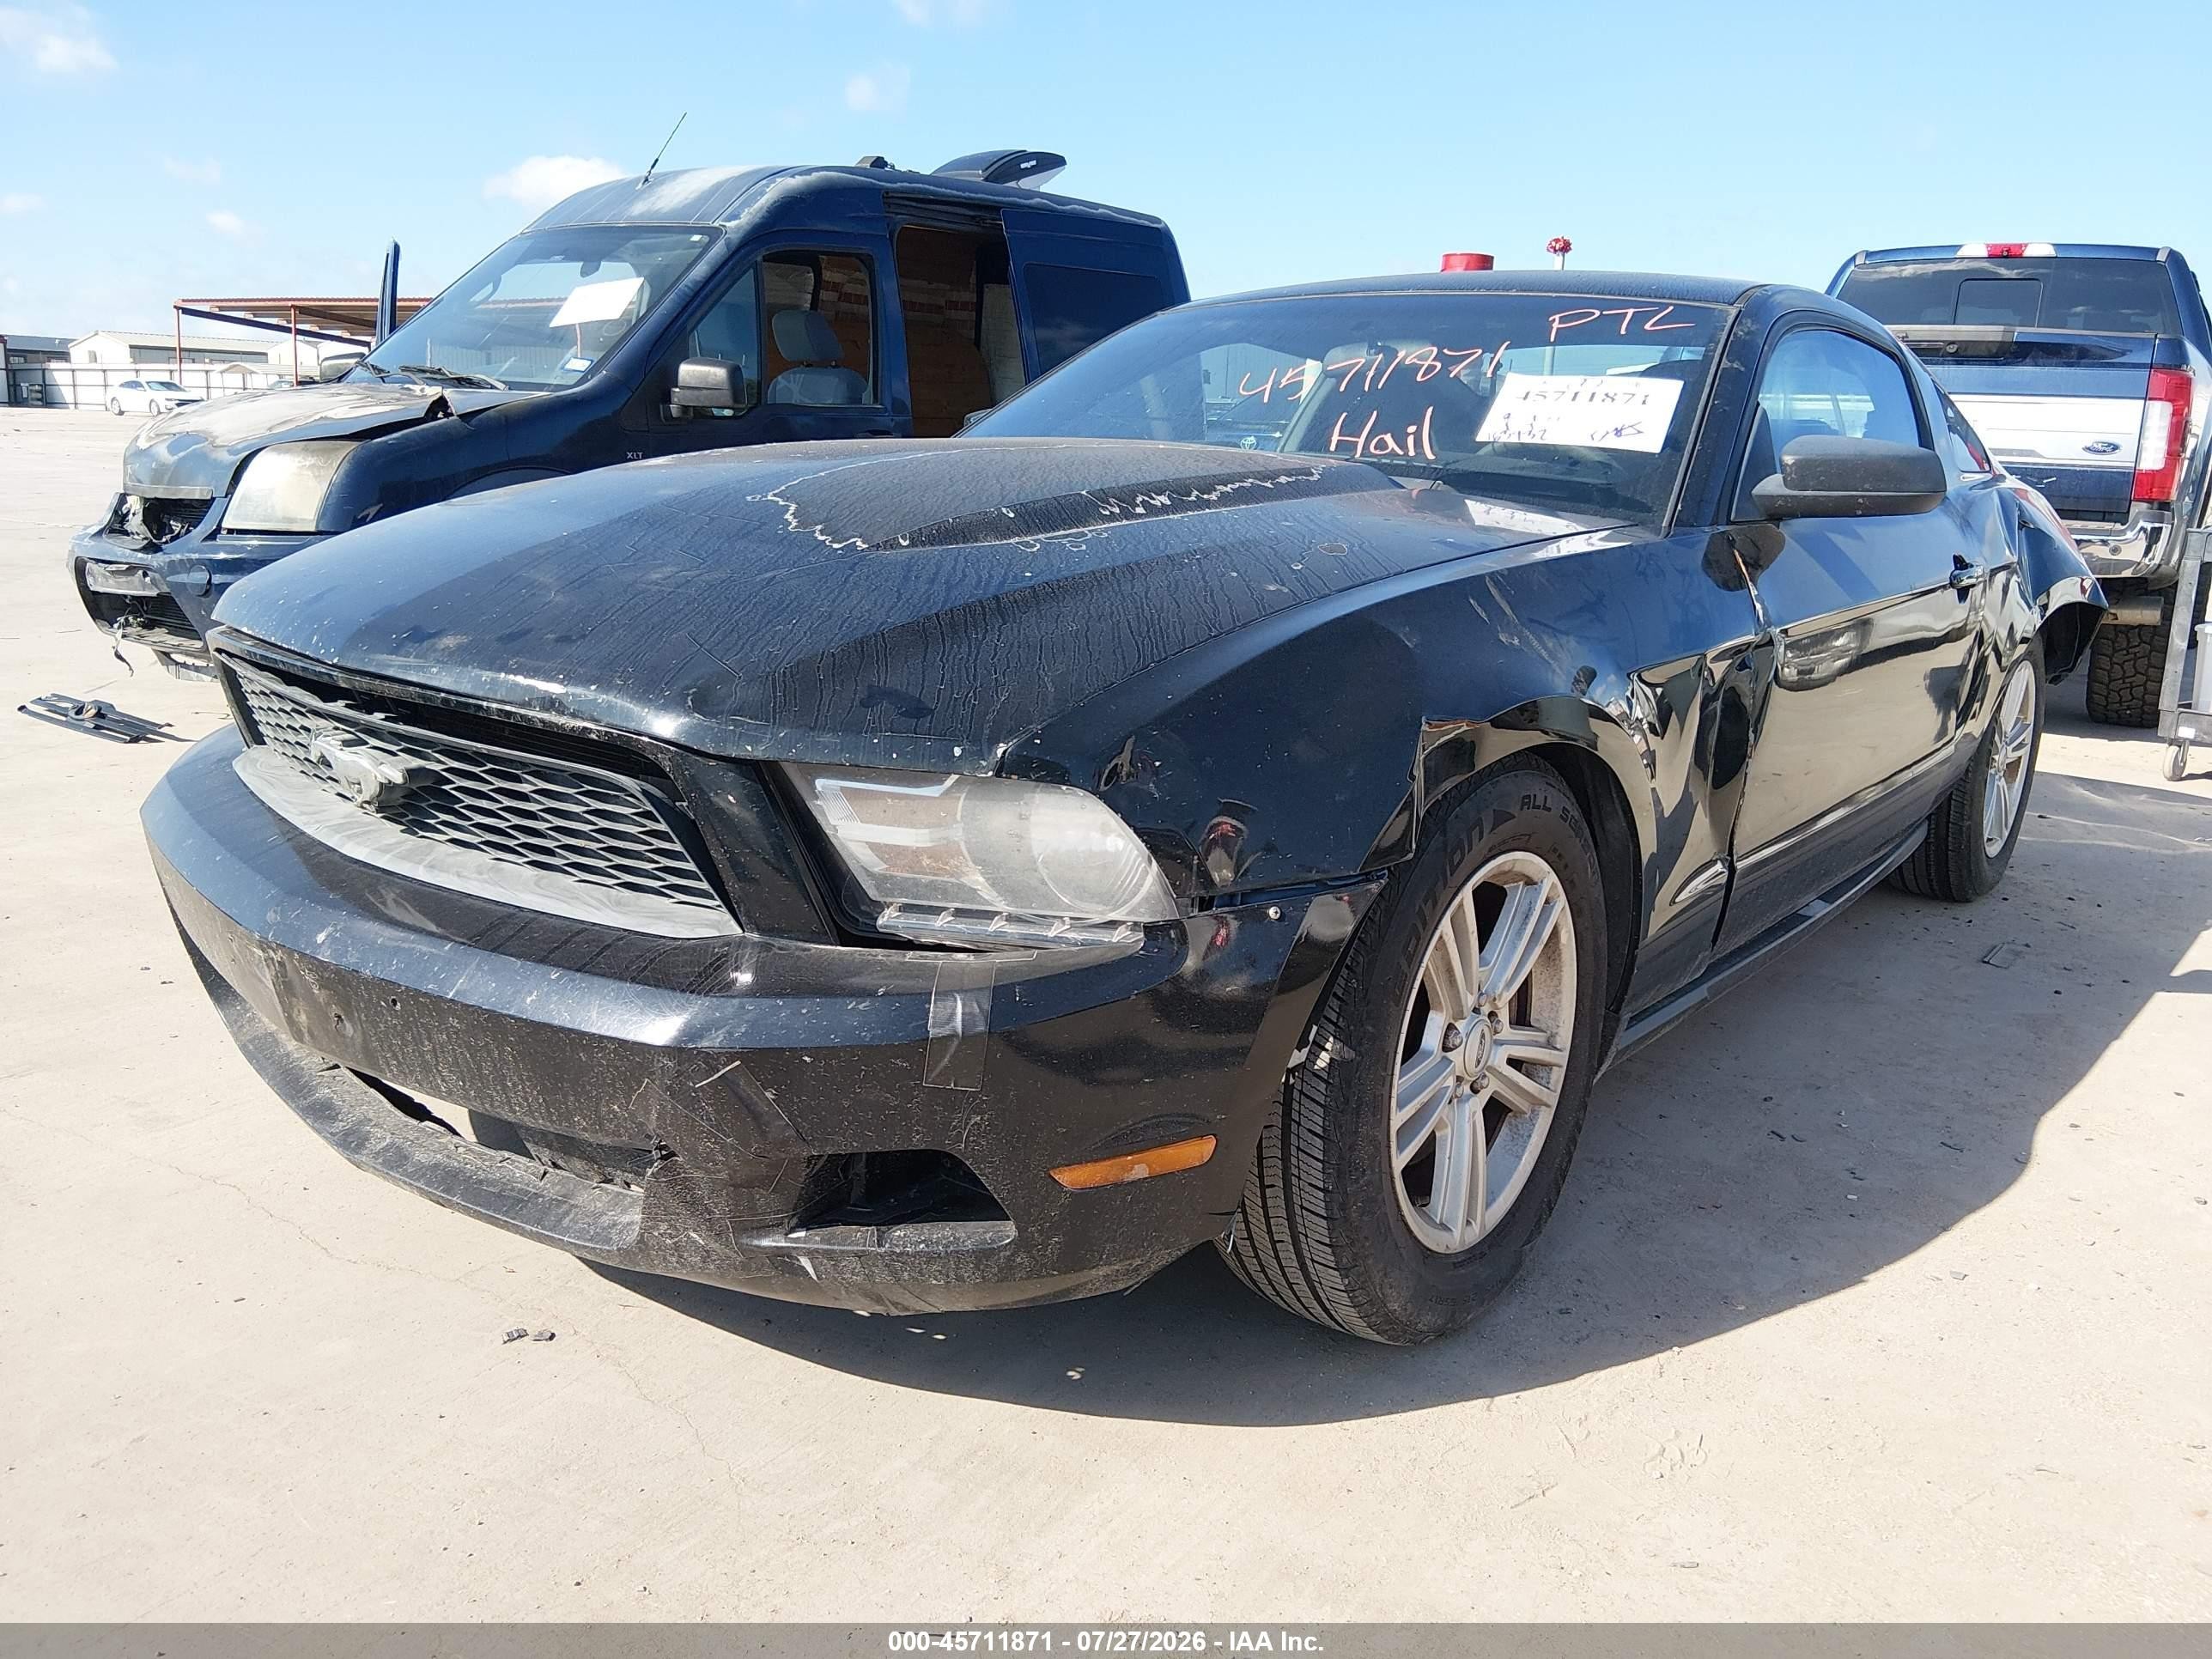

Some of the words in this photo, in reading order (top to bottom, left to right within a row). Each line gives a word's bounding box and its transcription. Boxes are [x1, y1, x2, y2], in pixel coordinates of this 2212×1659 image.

[1548, 306, 1697, 342] PTL
[1238, 341, 1511, 404] 45711871
[1330, 405, 1437, 459] Hail
[1519, 793, 1553, 813] ALL
